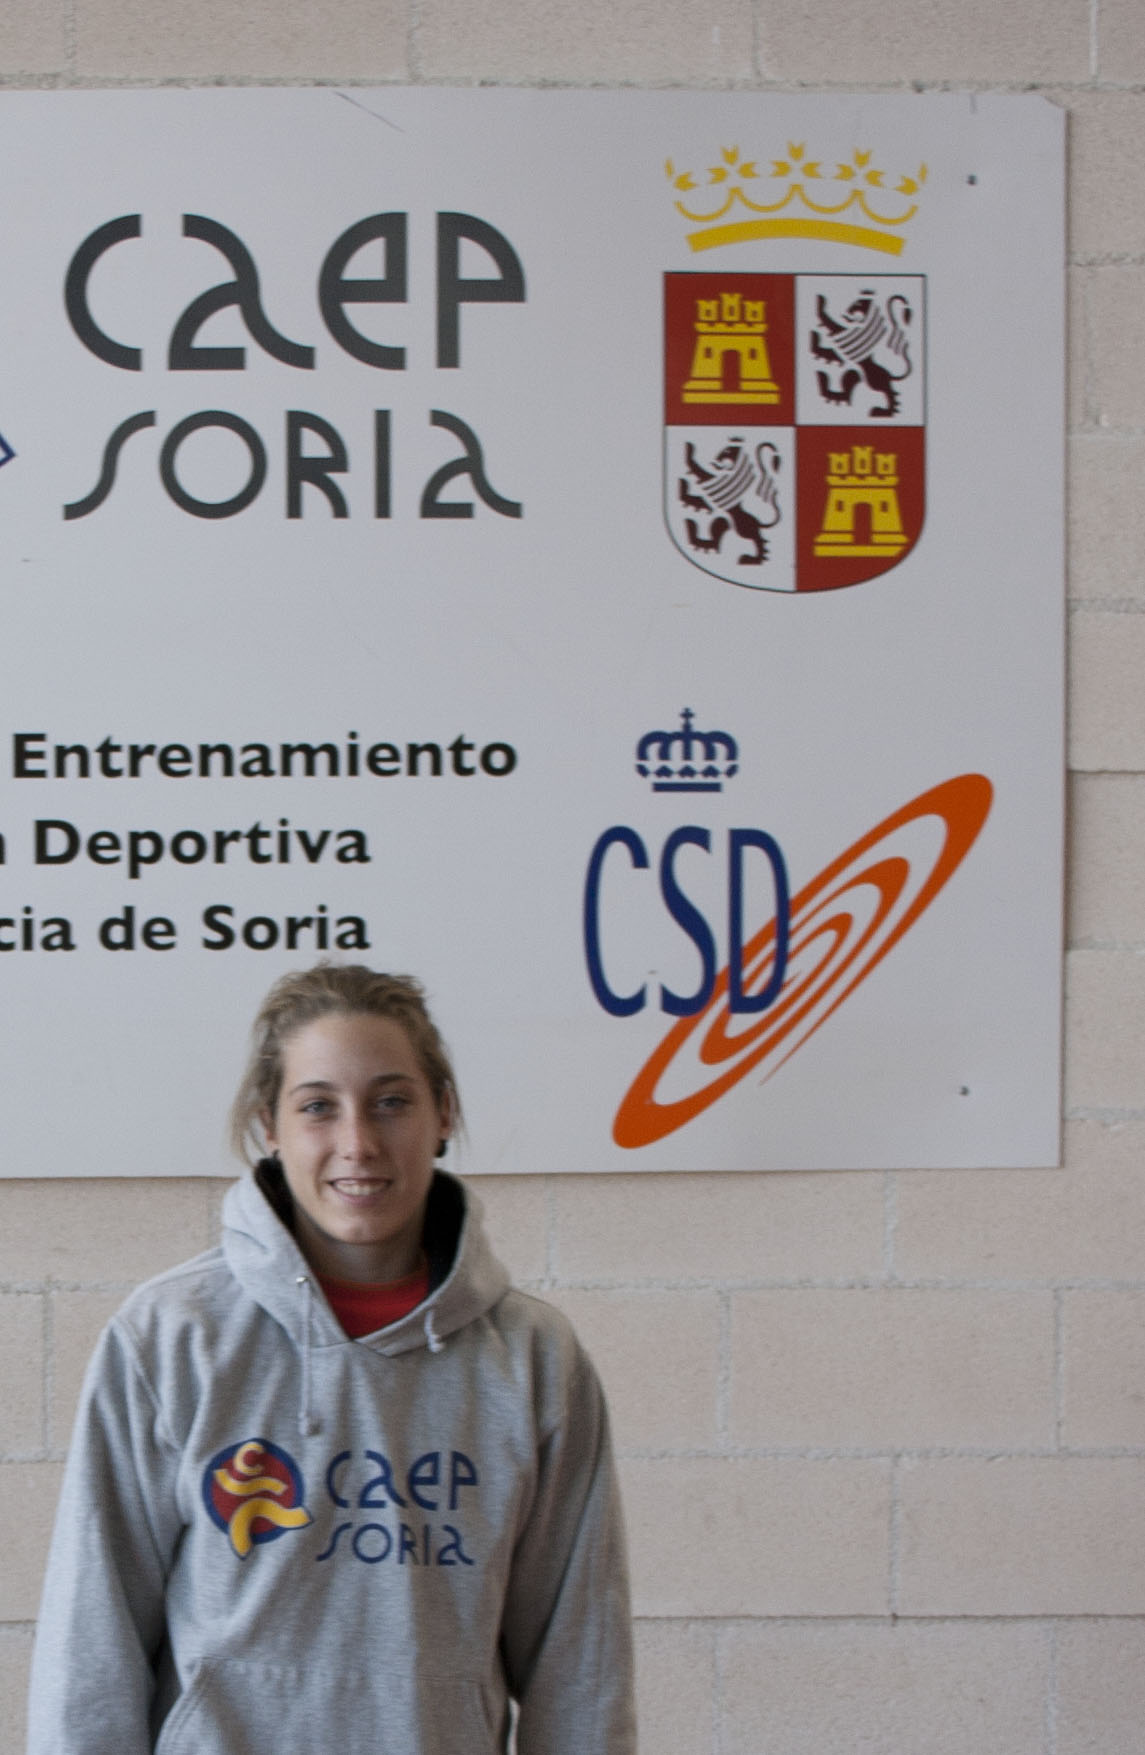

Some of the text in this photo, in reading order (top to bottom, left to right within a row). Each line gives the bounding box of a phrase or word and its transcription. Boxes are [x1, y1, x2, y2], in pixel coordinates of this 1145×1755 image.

[12, 731, 518, 779] Entrenamiento
[34, 817, 372, 880] Deportiva
[98, 905, 178, 952] de
[202, 904, 371, 951] Soria
[584, 825, 791, 1017] CSD
